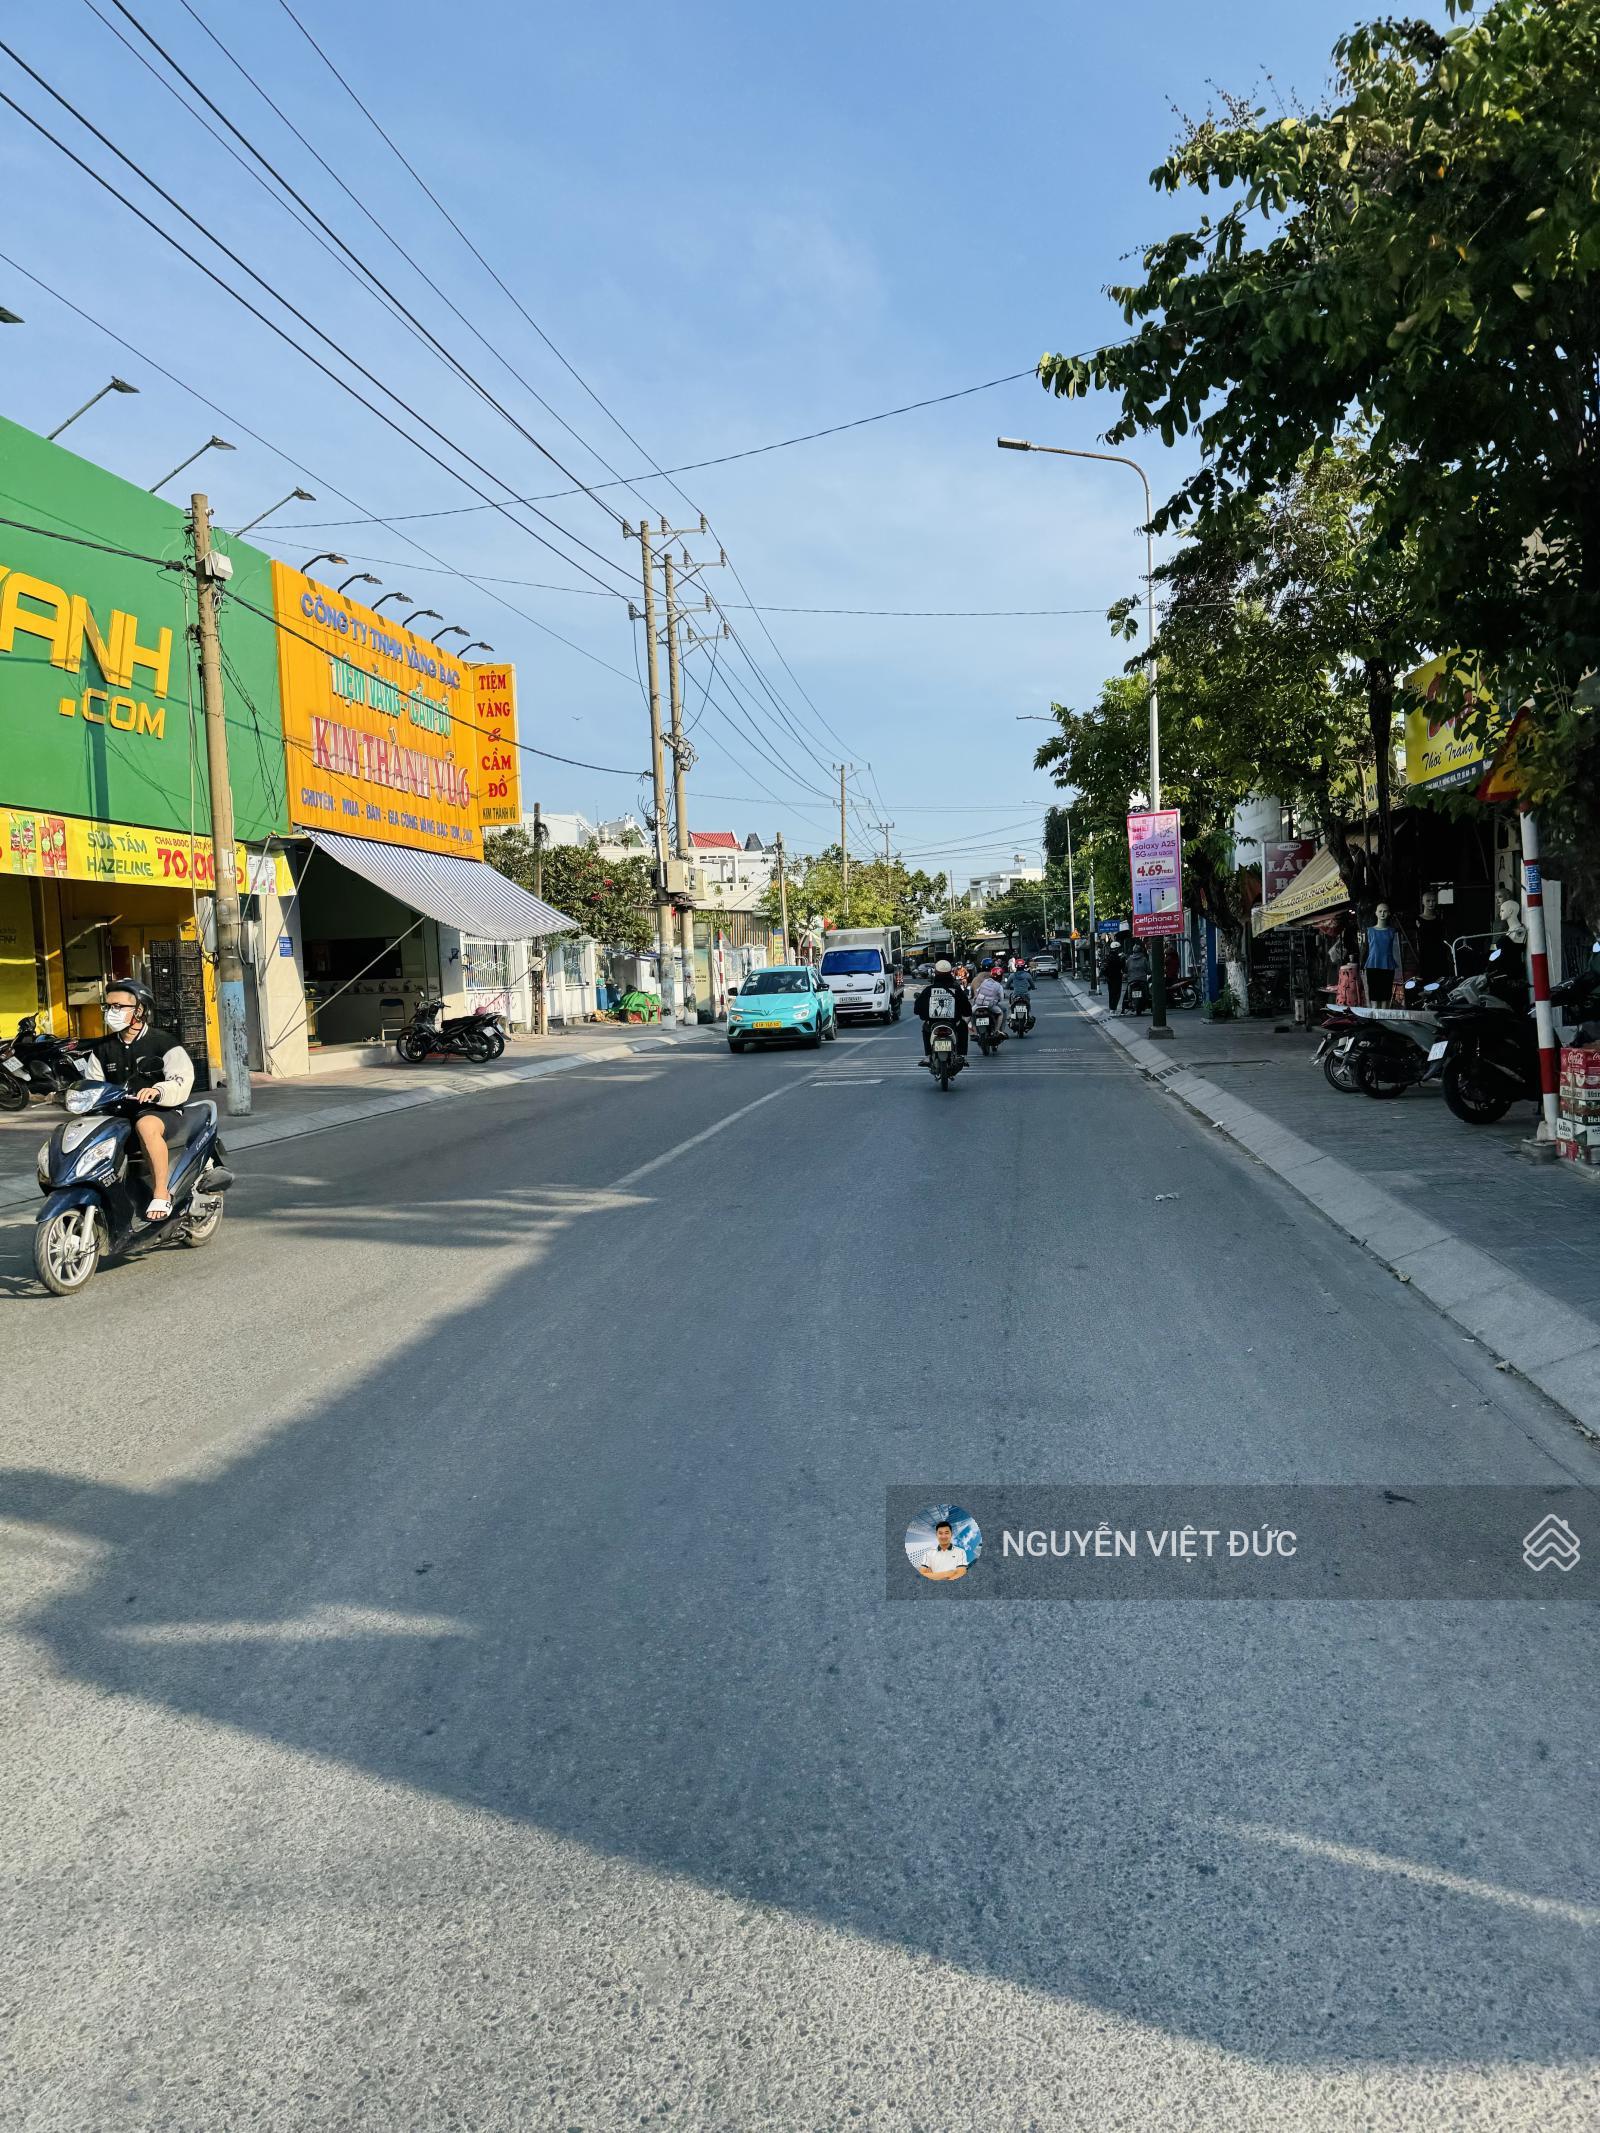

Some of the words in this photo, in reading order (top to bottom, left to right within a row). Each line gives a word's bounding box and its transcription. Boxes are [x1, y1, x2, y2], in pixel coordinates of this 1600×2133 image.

[0, 565, 173, 700] ANH
[301, 592, 349, 635] CÔNG
[350, 617, 368, 645] TY
[370, 626, 403, 664] TNHH
[405, 645, 437, 679] VÀNG
[439, 661, 461, 690] BẠC
[478, 670, 507, 693] TIỆM
[477, 698, 511, 718] VÀNG
[313, 716, 360, 779] KIM
[481, 747, 512, 771] CẦM
[1445, 741, 1474, 761] Trang
[488, 775, 508, 798] ĐỒ
[342, 797, 360, 817] MUA
[482, 807, 492, 820] KIM
[87, 828, 117, 851] SỮA
[117, 831, 148, 855] TẮM
[1131, 842, 1160, 851] Galaxy
[1161, 840, 1176, 848] A25
[1135, 850, 1146, 858] 5G
[86, 855, 154, 878] HAZELINE
[1136, 864, 1162, 877] 4.69
